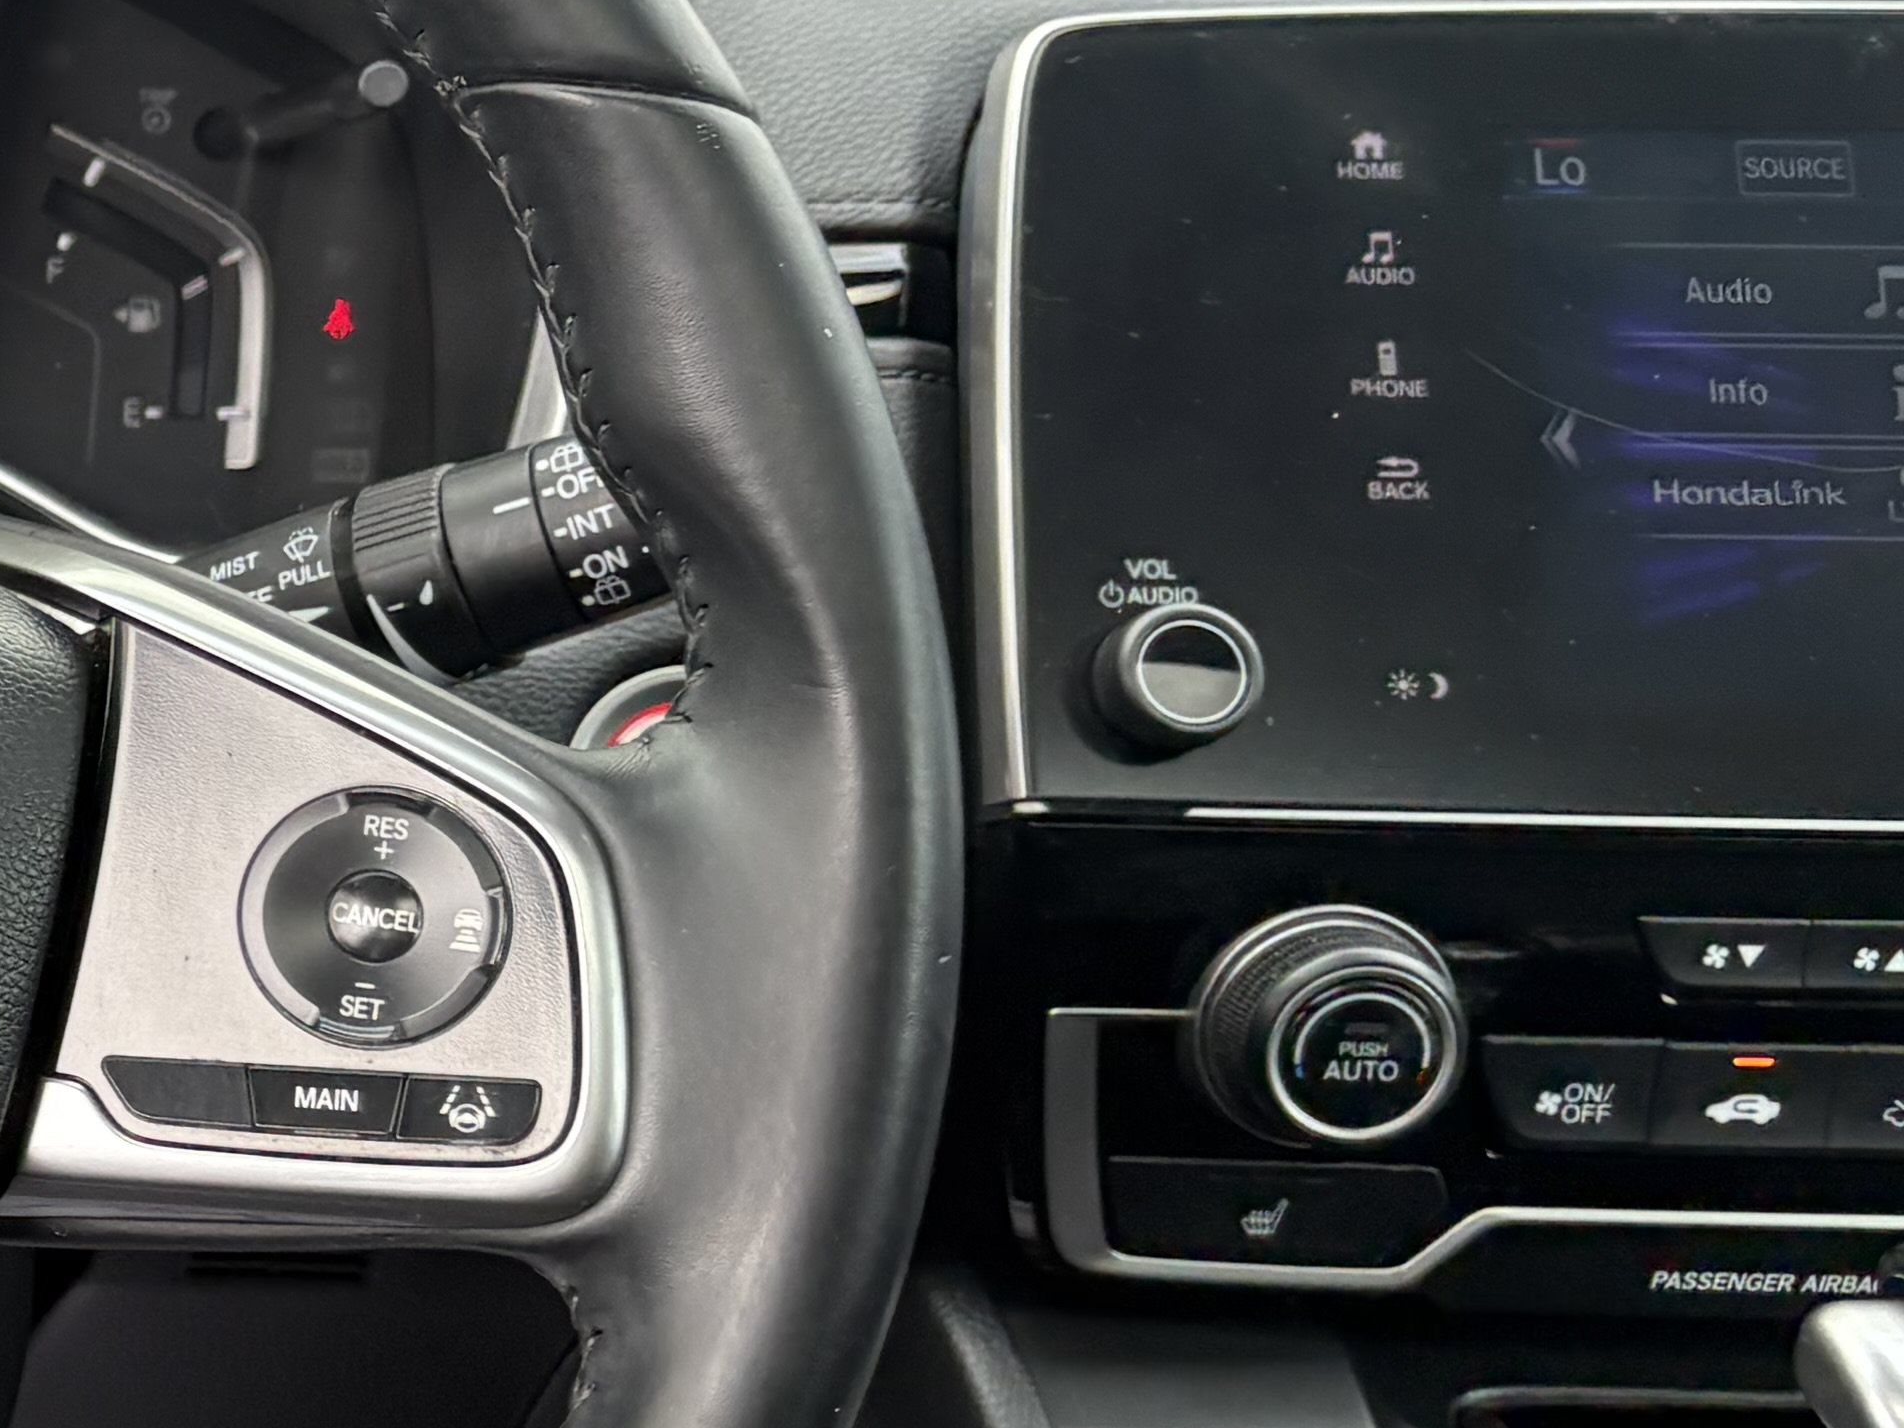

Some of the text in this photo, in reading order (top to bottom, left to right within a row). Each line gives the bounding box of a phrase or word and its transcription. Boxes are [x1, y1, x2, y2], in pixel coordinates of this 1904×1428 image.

[1337, 161, 1404, 181] HOME
[1535, 149, 1586, 186] Lo
[1743, 156, 1846, 181] SOURCE
[1345, 266, 1415, 286] AUDIO
[1685, 277, 1773, 304] Audio
[1349, 378, 1428, 399] PHONE
[1708, 376, 1769, 406] Info
[556, 466, 604, 499] OF
[1367, 481, 1430, 502] BACK
[1652, 479, 1847, 507] HondaLink
[566, 503, 615, 540] INT
[210, 550, 261, 582] MIST
[583, 545, 629, 579] ON
[1125, 559, 1176, 580] VOL
[277, 560, 331, 591] PULL
[1127, 585, 1198, 606] AUDIO
[363, 814, 409, 840] RES
[331, 902, 420, 934] CANCEL
[339, 996, 385, 1022] SET
[1338, 1041, 1389, 1058] PUSH
[1322, 1060, 1400, 1083] AUTO
[294, 1085, 360, 1113] MAIN
[1560, 1103, 1613, 1124] OFF
[1649, 1270, 1796, 1293] PASSENGER
